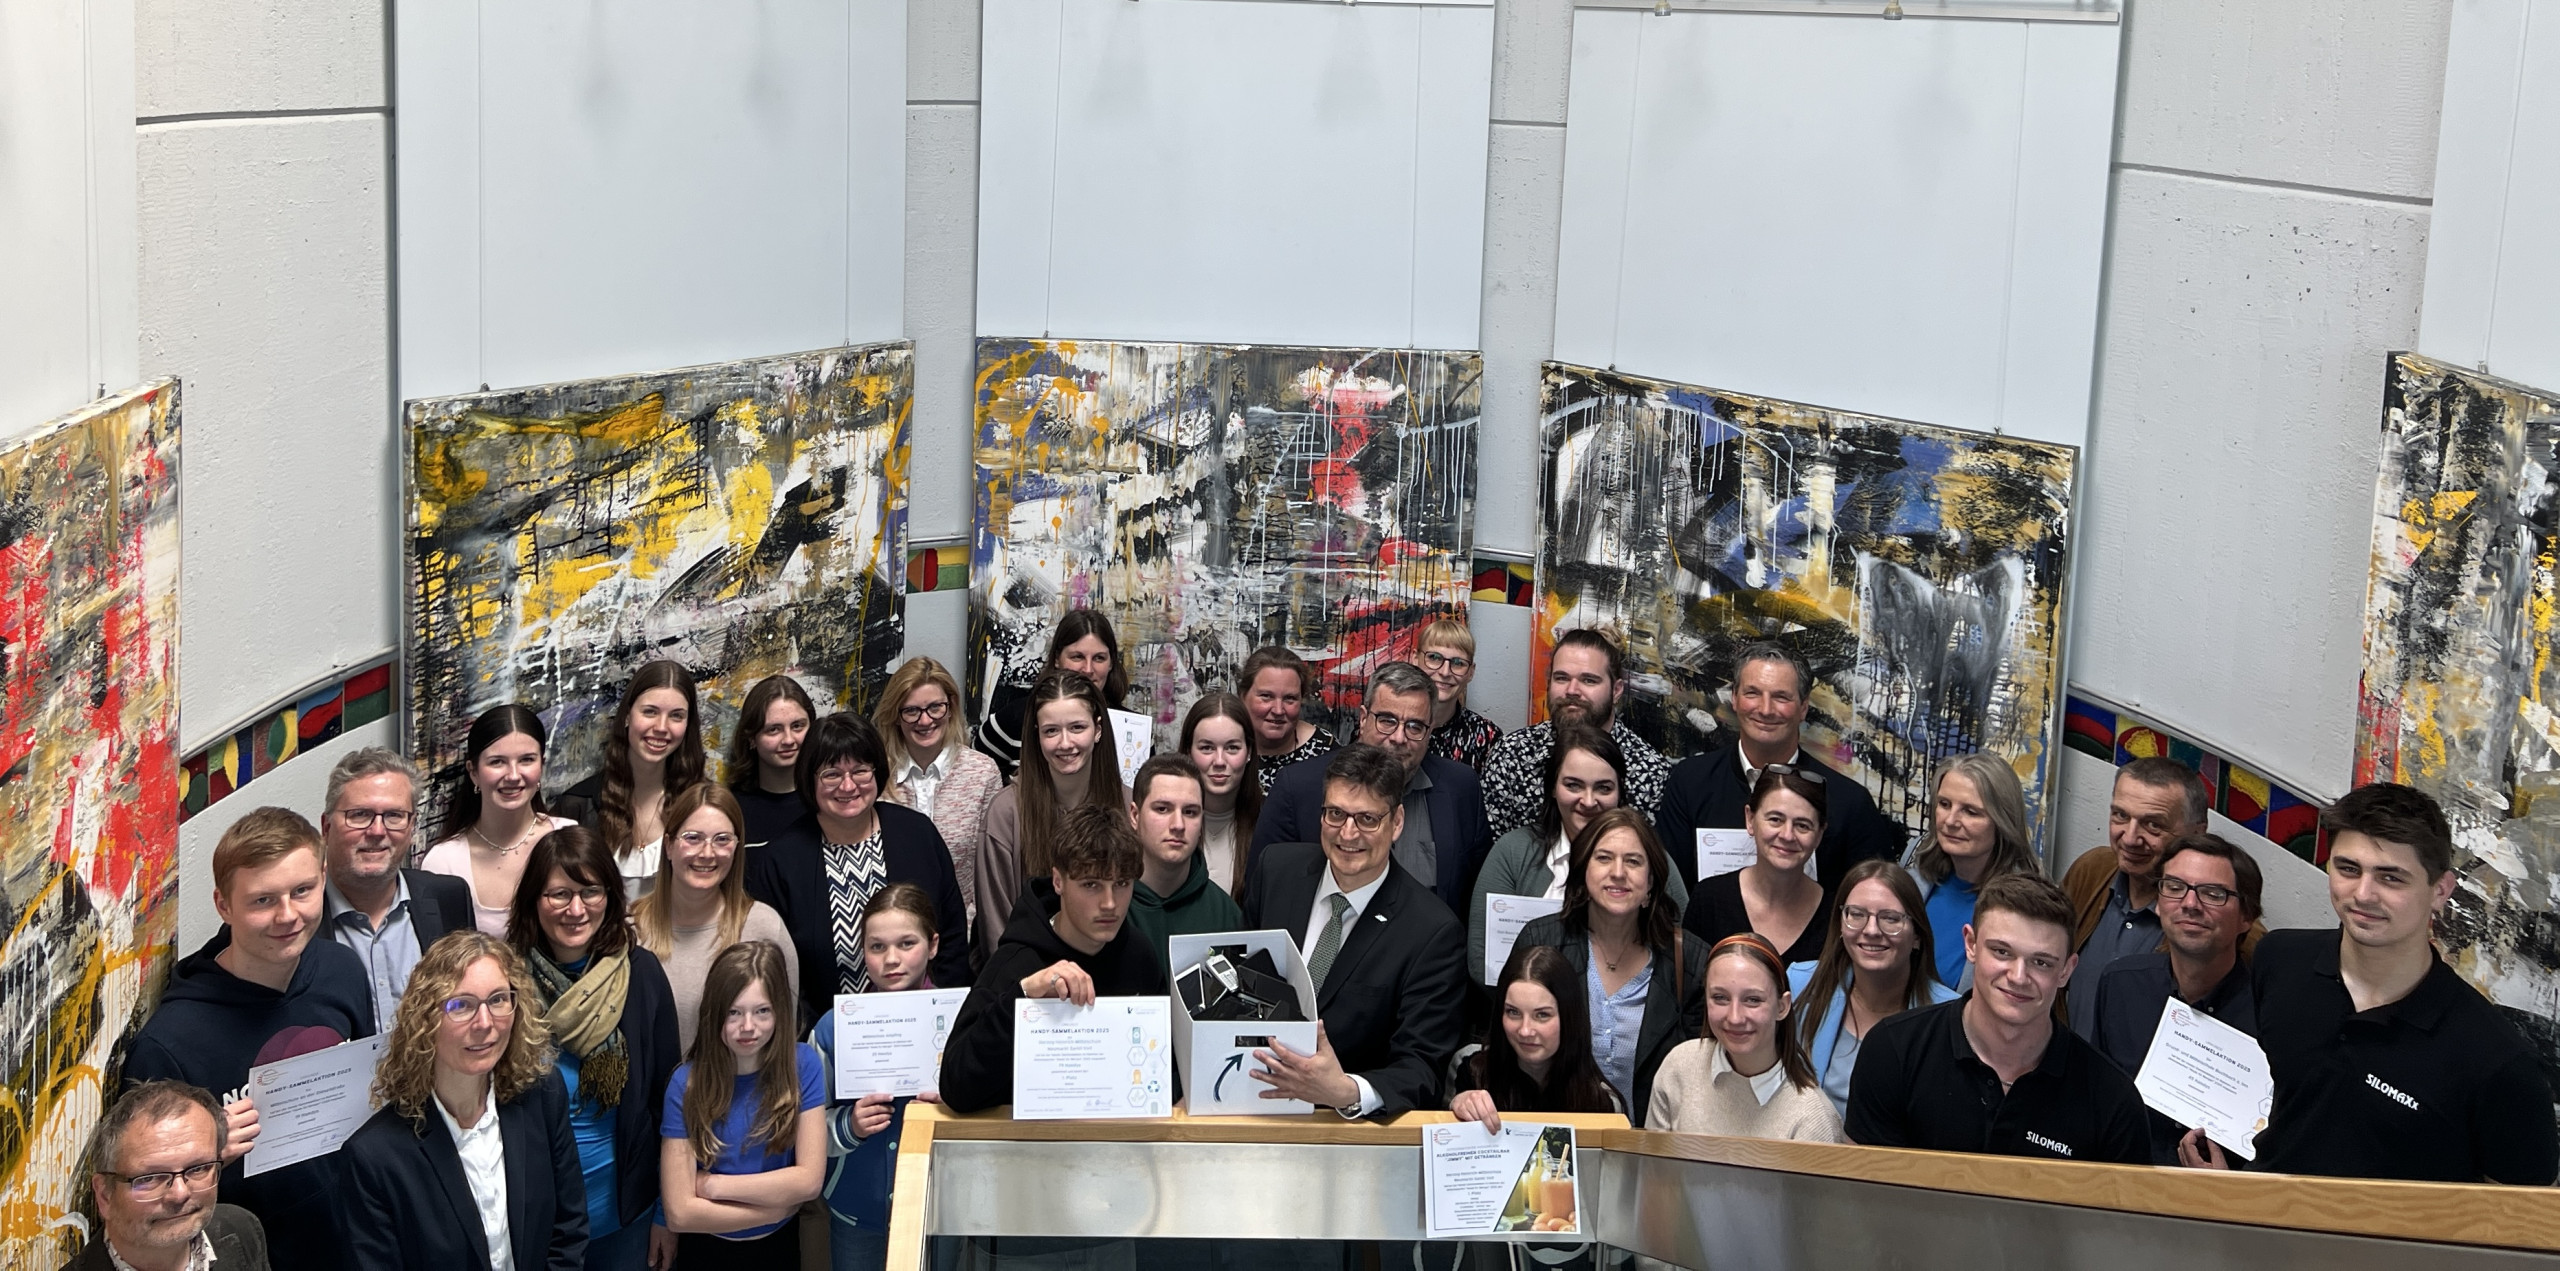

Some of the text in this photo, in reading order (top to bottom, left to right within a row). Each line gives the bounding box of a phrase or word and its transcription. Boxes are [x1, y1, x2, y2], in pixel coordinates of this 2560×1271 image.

[2173, 1030, 2237, 1066] HANDY-SAMMELAKTION
[2237, 1062, 2251, 1073] 2025
[265, 1072, 336, 1095] HANDY-SAMMELAKTION
